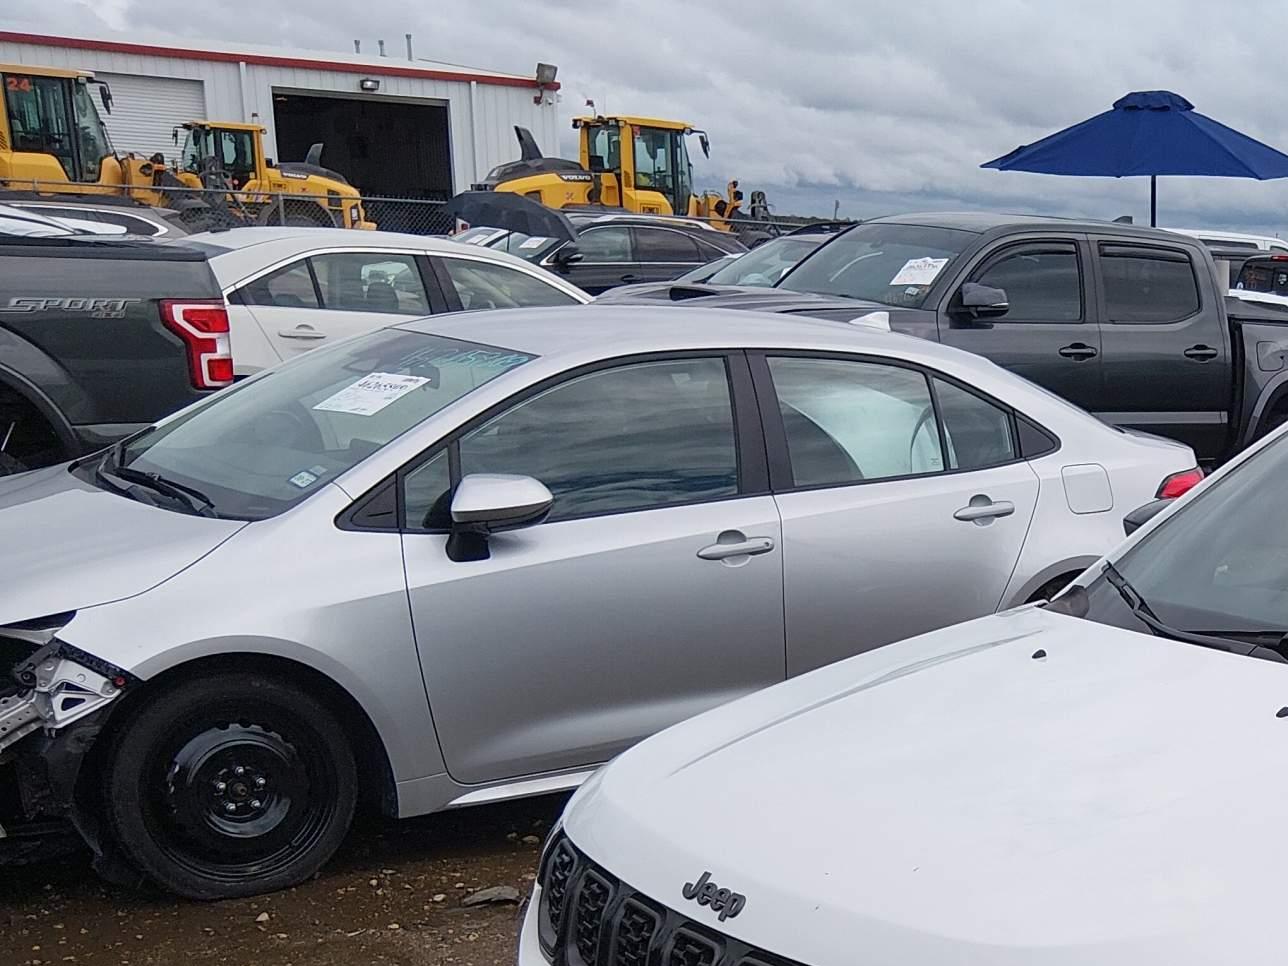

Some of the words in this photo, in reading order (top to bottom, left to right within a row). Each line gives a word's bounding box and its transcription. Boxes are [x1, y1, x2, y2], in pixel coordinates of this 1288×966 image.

[7, 77, 32, 92] 24
[1, 297, 142, 313] SPORT
[682, 871, 746, 922] Jeep
